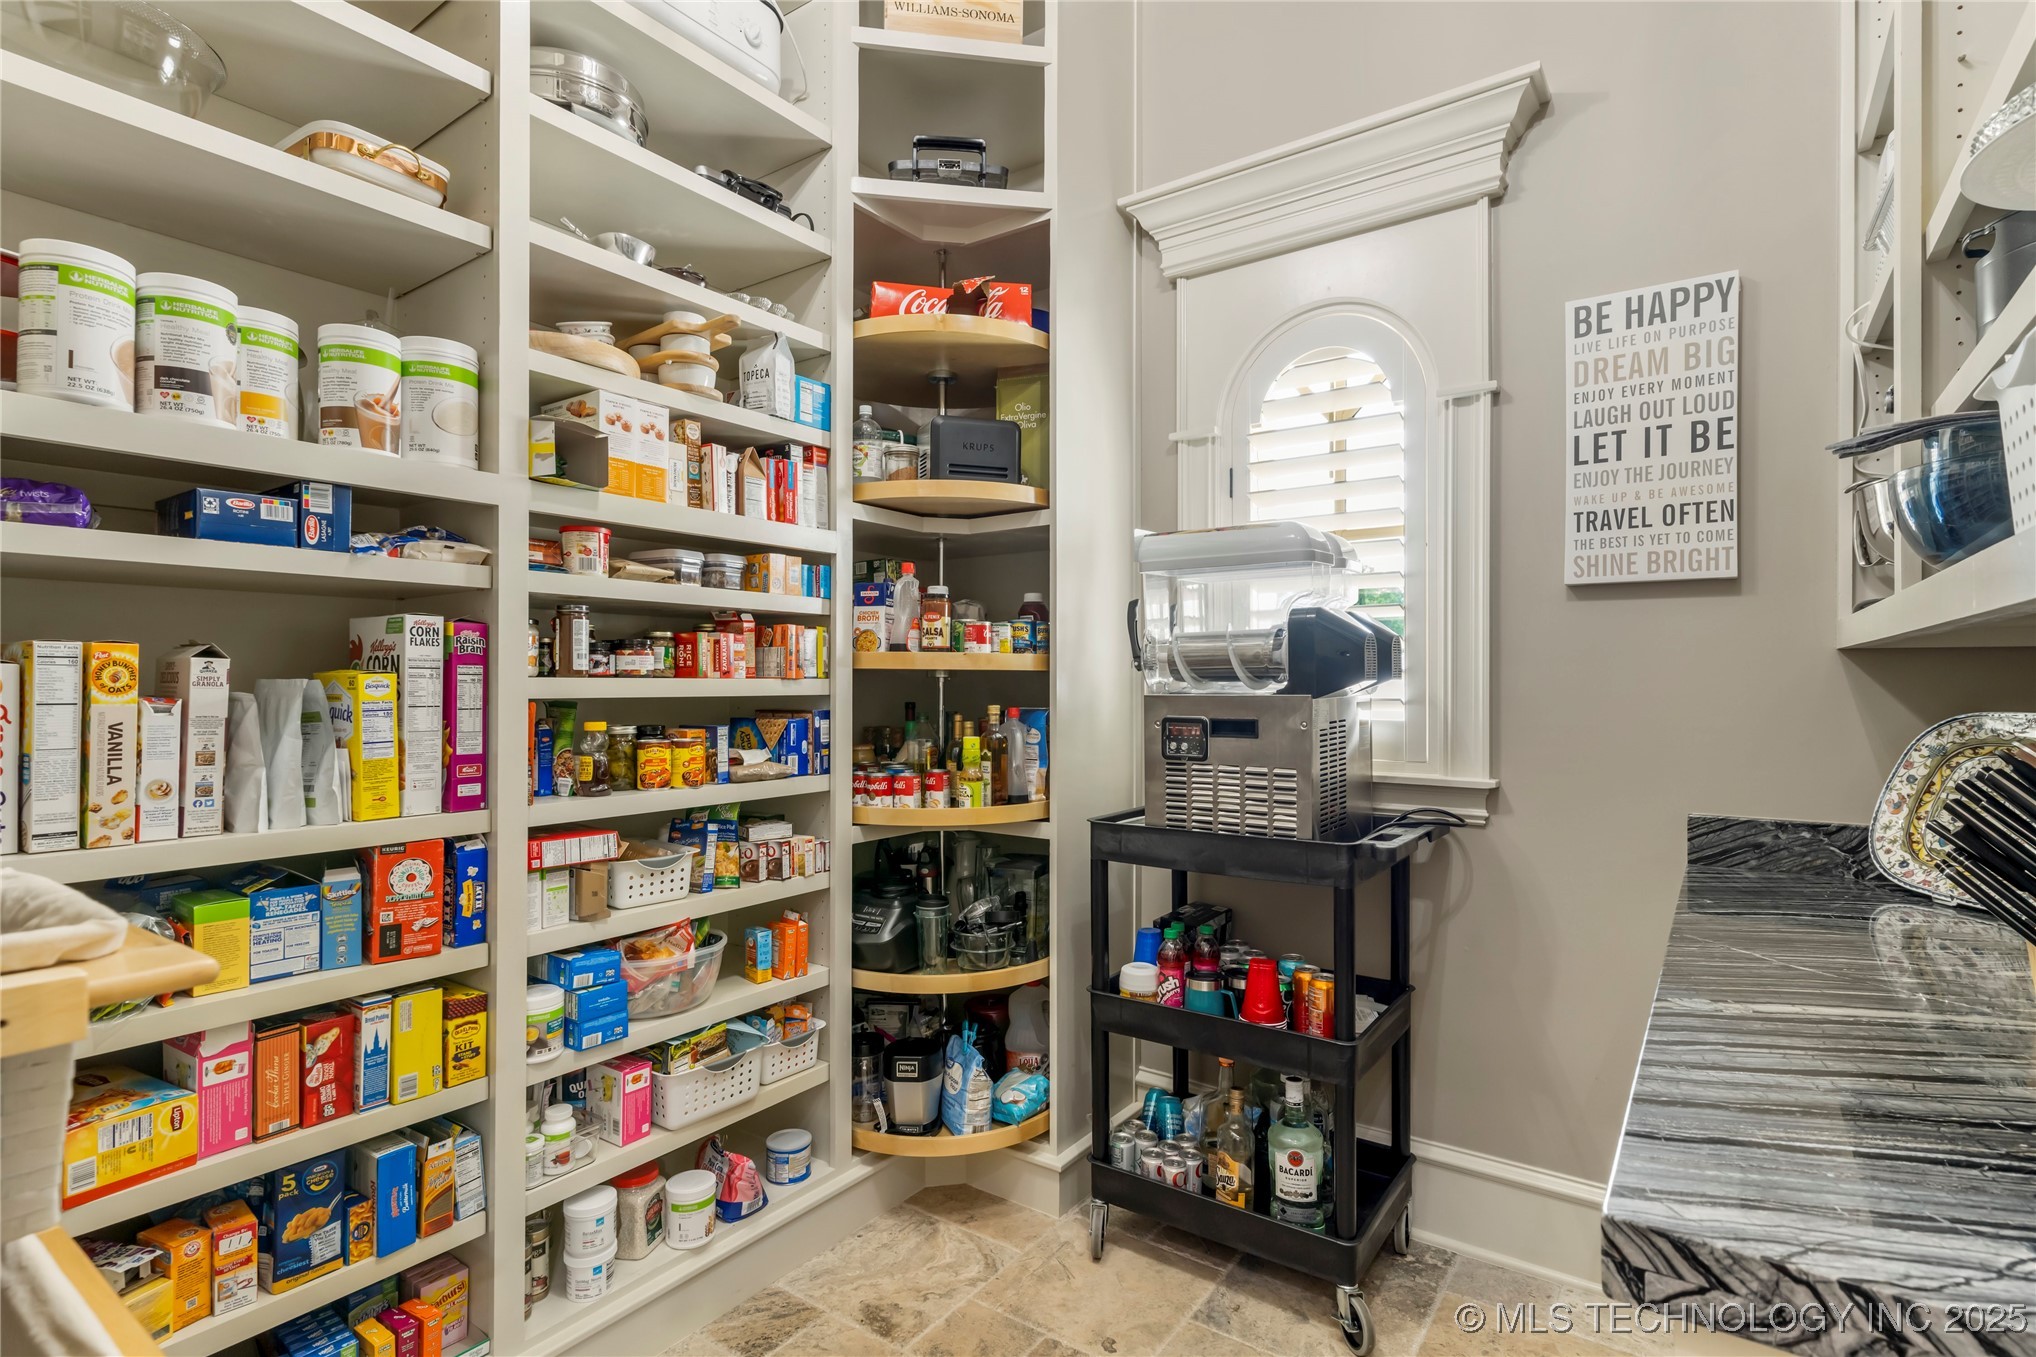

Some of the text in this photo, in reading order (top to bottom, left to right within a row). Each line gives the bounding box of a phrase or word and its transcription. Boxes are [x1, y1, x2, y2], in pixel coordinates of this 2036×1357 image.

[894, 2, 1015, 24] WILLIAMS-SONOMA
[84, 273, 129, 292] HERBALIFE
[84, 279, 129, 298] NUTRITION
[69, 290, 101, 304] Protein
[899, 289, 948, 315] Coca
[172, 301, 219, 315] HERBALIFE
[172, 306, 219, 321] NUTRITION
[1574, 276, 1735, 339] BE HAPPY
[258, 333, 293, 347] HERBALIFE
[1574, 317, 1735, 355] LIVE LIFE ON PURPOSE
[416, 364, 450, 372] HERBALIFE
[1574, 336, 1735, 388] DREAM BIG
[67, 375, 82, 383] NET
[416, 368, 451, 376] NUTRITION
[743, 368, 770, 382] TOPECA
[67, 381, 83, 390] 22.5
[84, 383, 95, 392] OZ
[1574, 370, 1735, 405] ENJOY EVERY MOMENT
[1014, 402, 1031, 412] Olio
[1574, 390, 1735, 429] LAUGH OUT LOUD
[1016, 420, 1037, 429] Oliva
[962, 441, 995, 452] KRUPS
[1574, 416, 1735, 466] LET IT BE
[1574, 457, 1734, 489] ENJOY THE JOURNEY
[19, 488, 50, 499] twists
[1574, 481, 1734, 506] WAKE UP & BE AWESOME
[1574, 499, 1734, 533] TRAVEL OFTEN
[308, 517, 316, 539] Barilla
[1574, 529, 1734, 551] THE BEST IS YET TO COME
[1573, 546, 1734, 578] SHINE BRIGHT
[409, 626, 440, 637] CORN
[413, 619, 437, 628] Kellogg's
[922, 626, 944, 638] SALSA
[370, 639, 397, 657] Kellogg's
[409, 637, 441, 647] FLAKES
[455, 635, 485, 647] Raisin
[459, 645, 482, 654] Bran
[95, 660, 137, 681] HONEY BUNCHES
[366, 655, 400, 671] CORN
[108, 683, 132, 693] OATS
[191, 680, 224, 688] GRANOLA
[365, 682, 390, 690] Bisquick
[329, 703, 353, 725] quick
[106, 721, 124, 786] VANILLA
[720, 810, 734, 819] Sides
[326, 889, 357, 900] Skittles
[252, 938, 283, 946] HEATING
[1157, 976, 1180, 1004] rush
[455, 1041, 474, 1052] KIT
[282, 1052, 290, 1083] GINGER
[173, 1107, 181, 1130] Lipton
[1215, 1165, 1236, 1187] Sauza
[1279, 1164, 1313, 1177] BACARDÍ
[281, 1173, 297, 1192] 5
[278, 1189, 299, 1201] pack
[276, 1259, 310, 1275] cheesiest
[286, 1265, 326, 1284] original flavor
[432, 1280, 467, 1308] arburst
